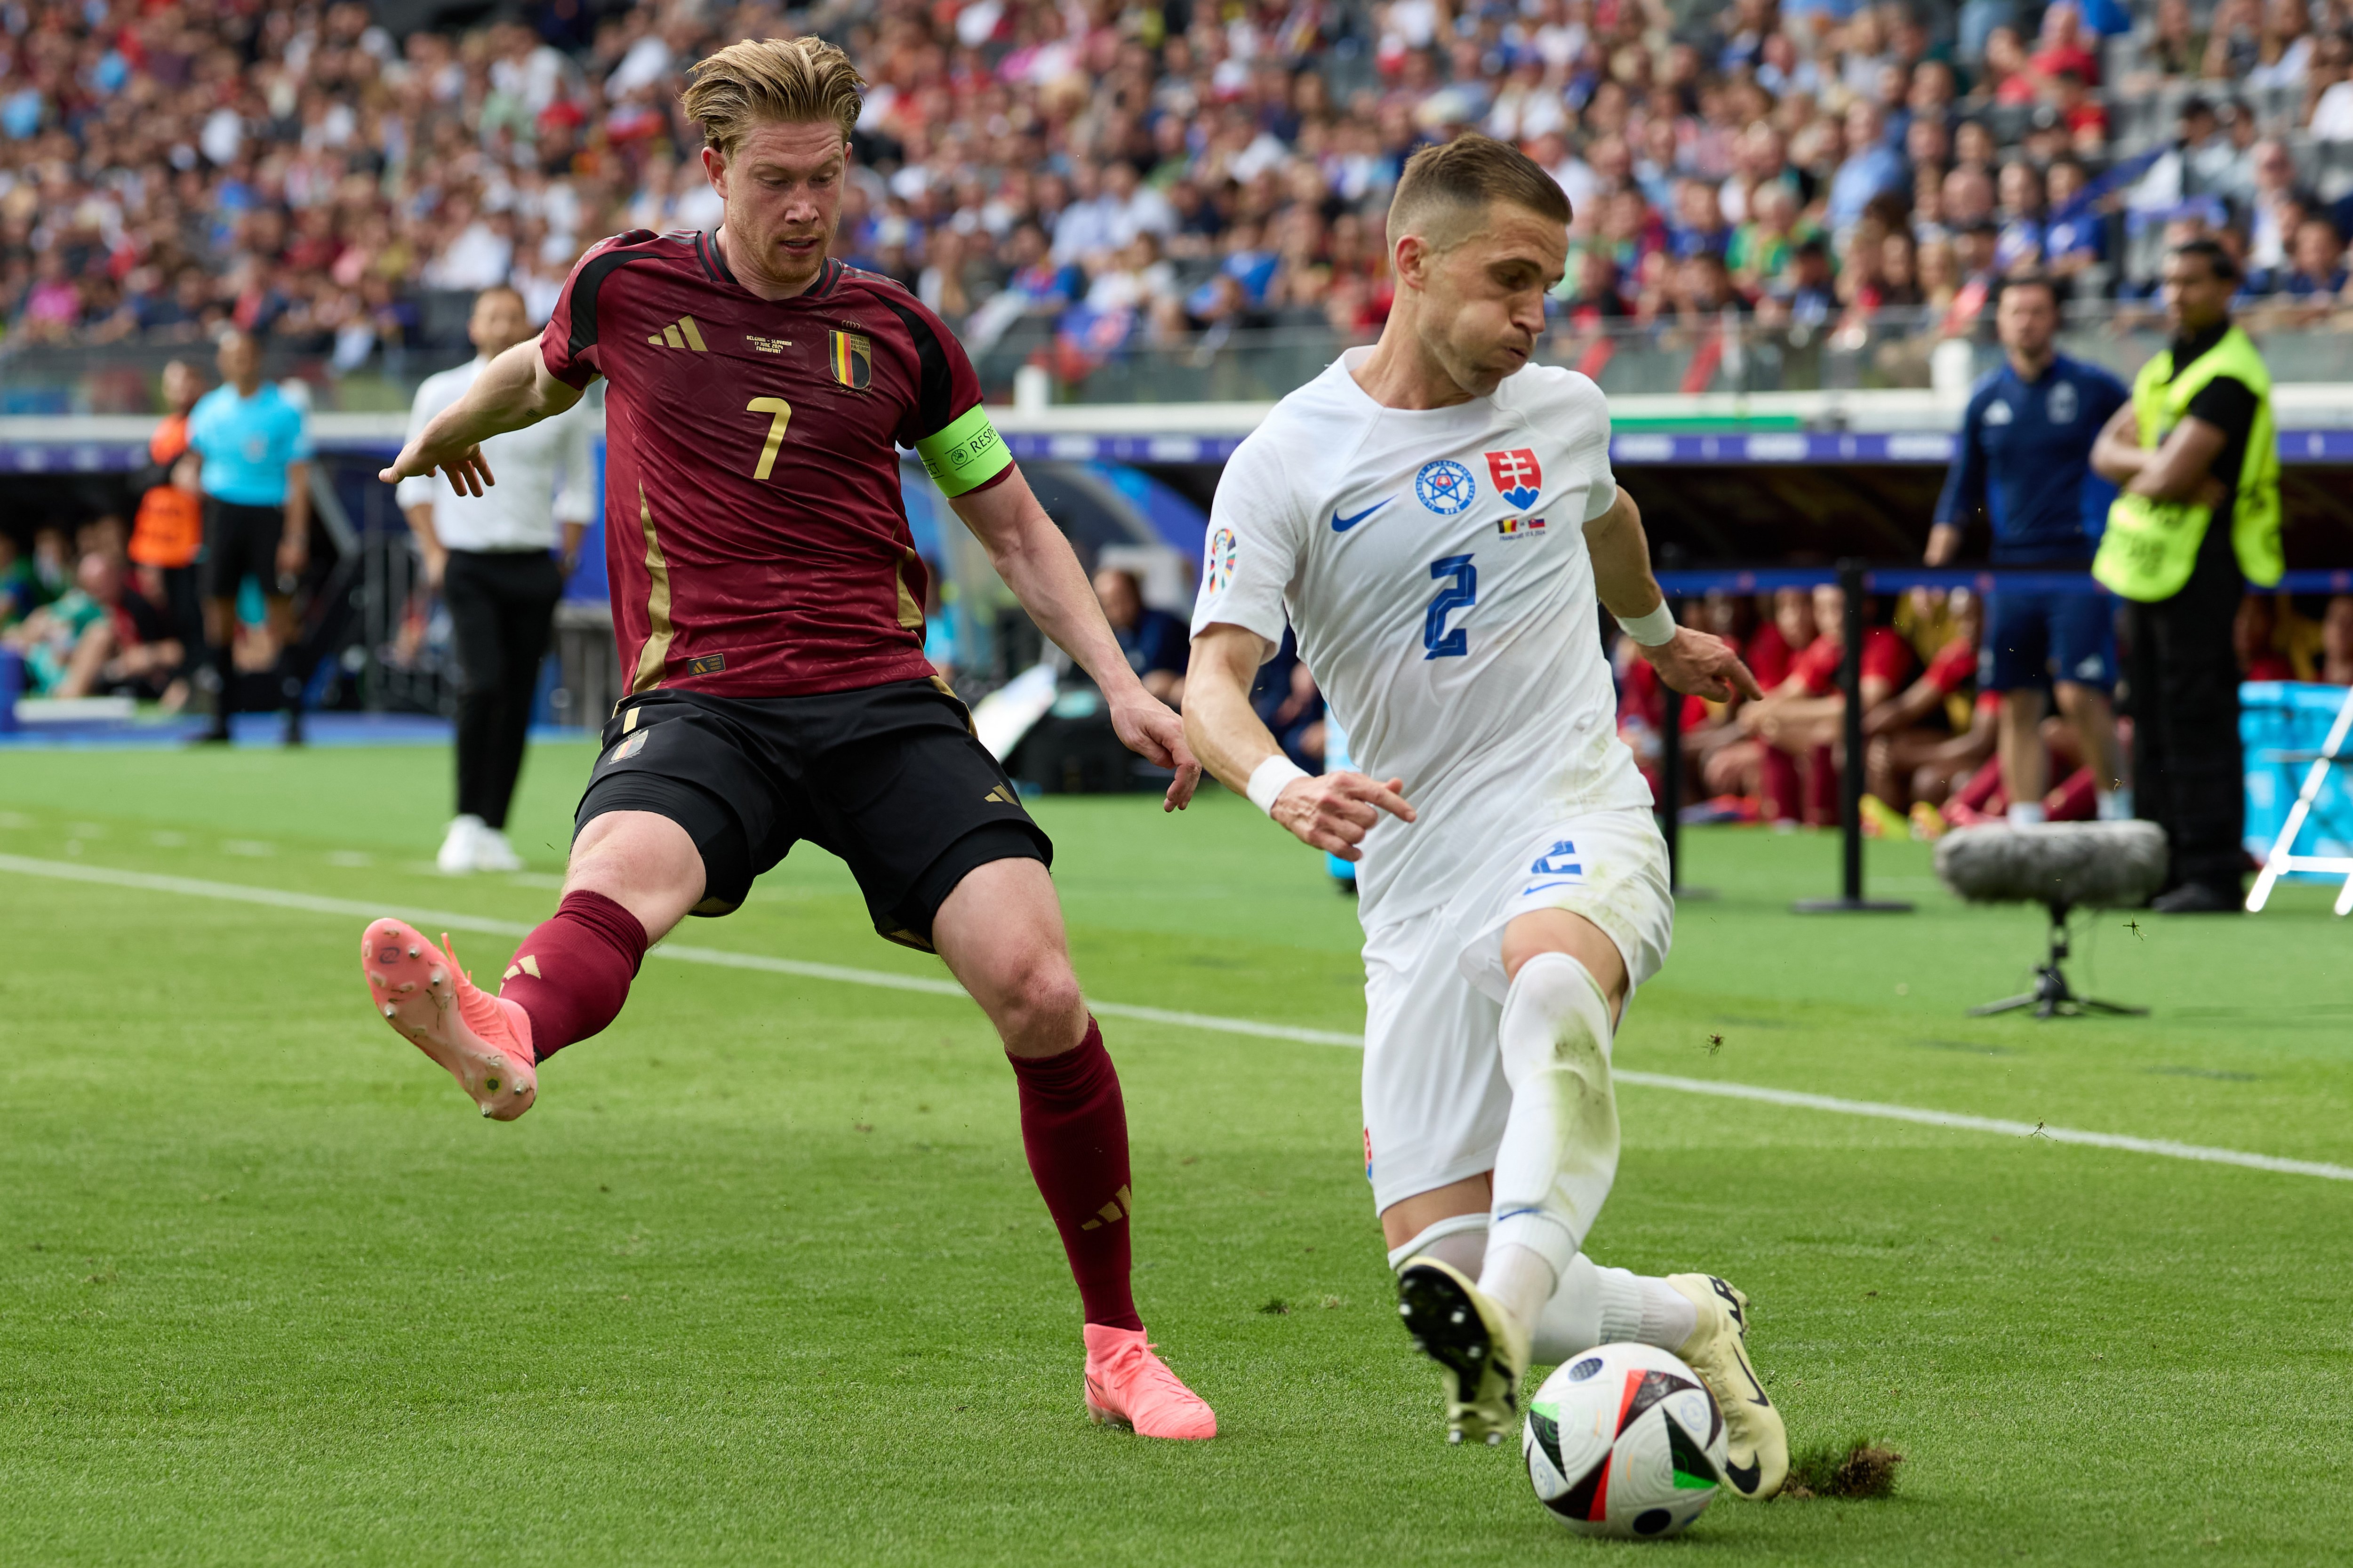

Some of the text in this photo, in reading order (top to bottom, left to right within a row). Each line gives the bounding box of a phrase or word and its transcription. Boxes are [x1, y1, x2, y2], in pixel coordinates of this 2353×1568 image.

[746, 397, 792, 480] 7
[1424, 553, 1477, 660] 2
[1531, 840, 1582, 876] 2
